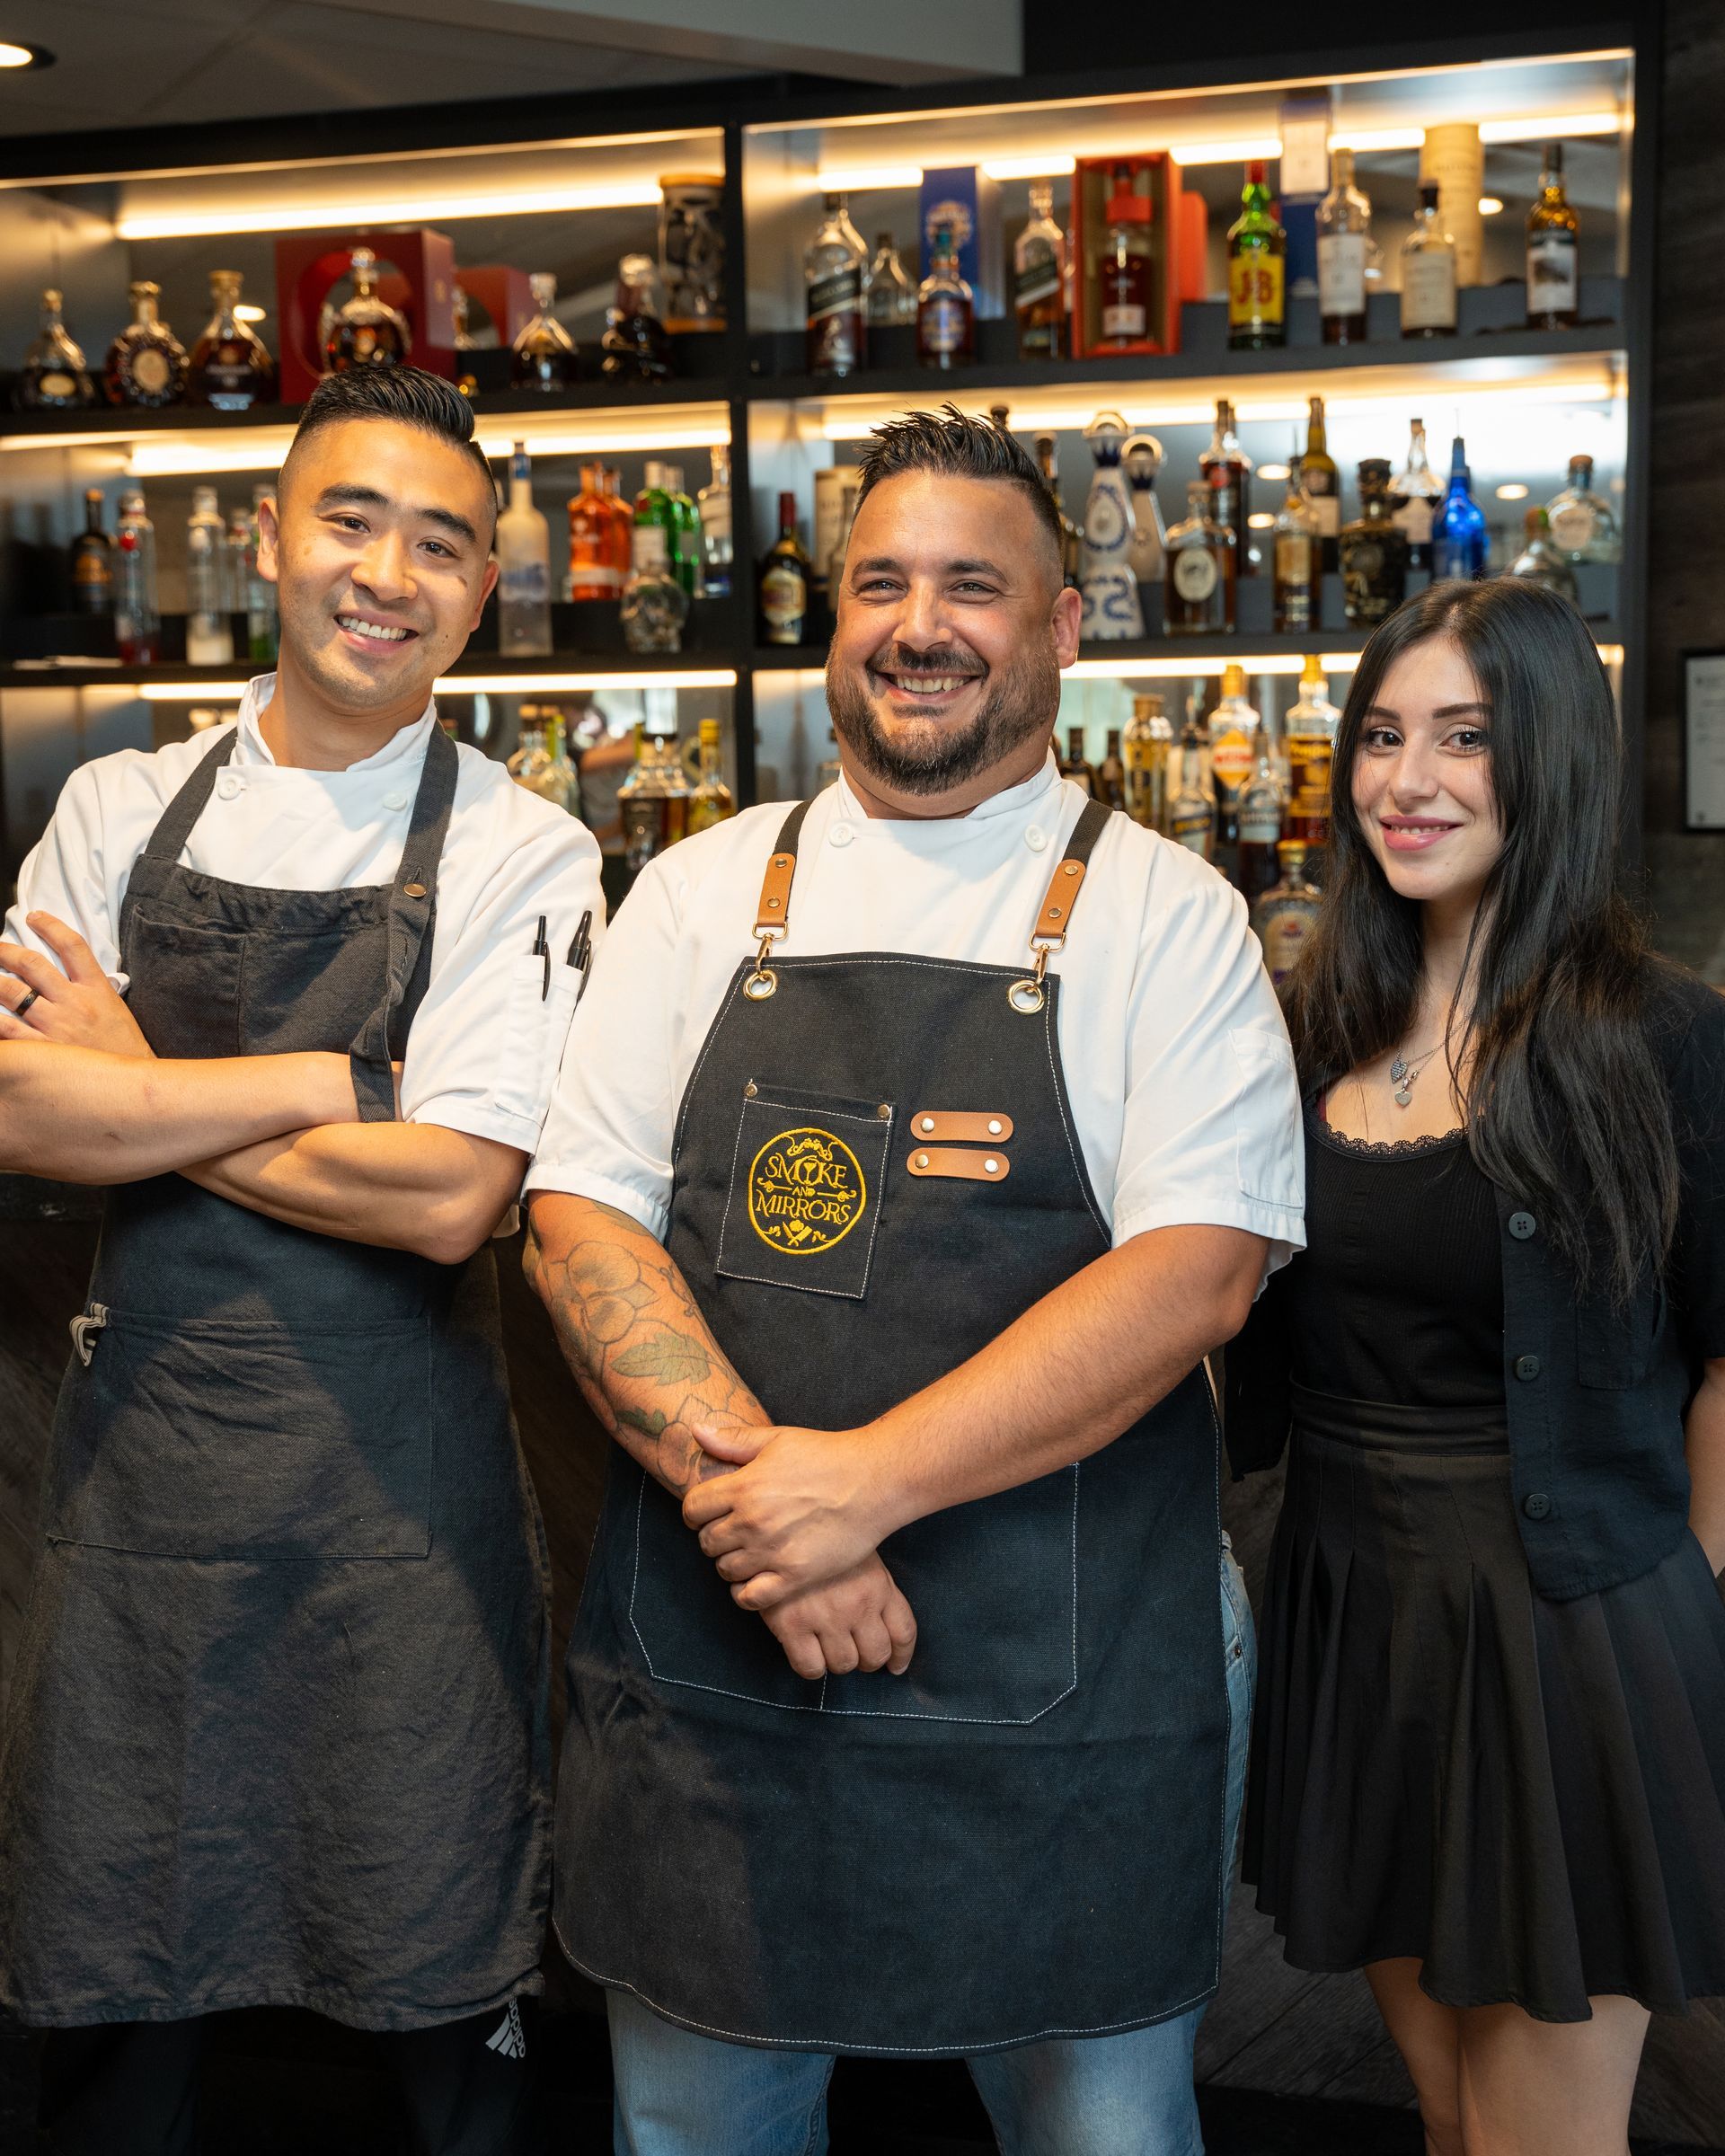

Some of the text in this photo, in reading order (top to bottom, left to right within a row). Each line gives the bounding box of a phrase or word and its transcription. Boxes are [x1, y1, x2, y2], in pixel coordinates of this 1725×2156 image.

[1237, 270, 1273, 305] JB
[765, 1153, 848, 1188] SMOKE
[756, 1188, 852, 1225] MIRRORS
[792, 1186, 816, 1197] AND
[509, 1998, 526, 2058] adidas
